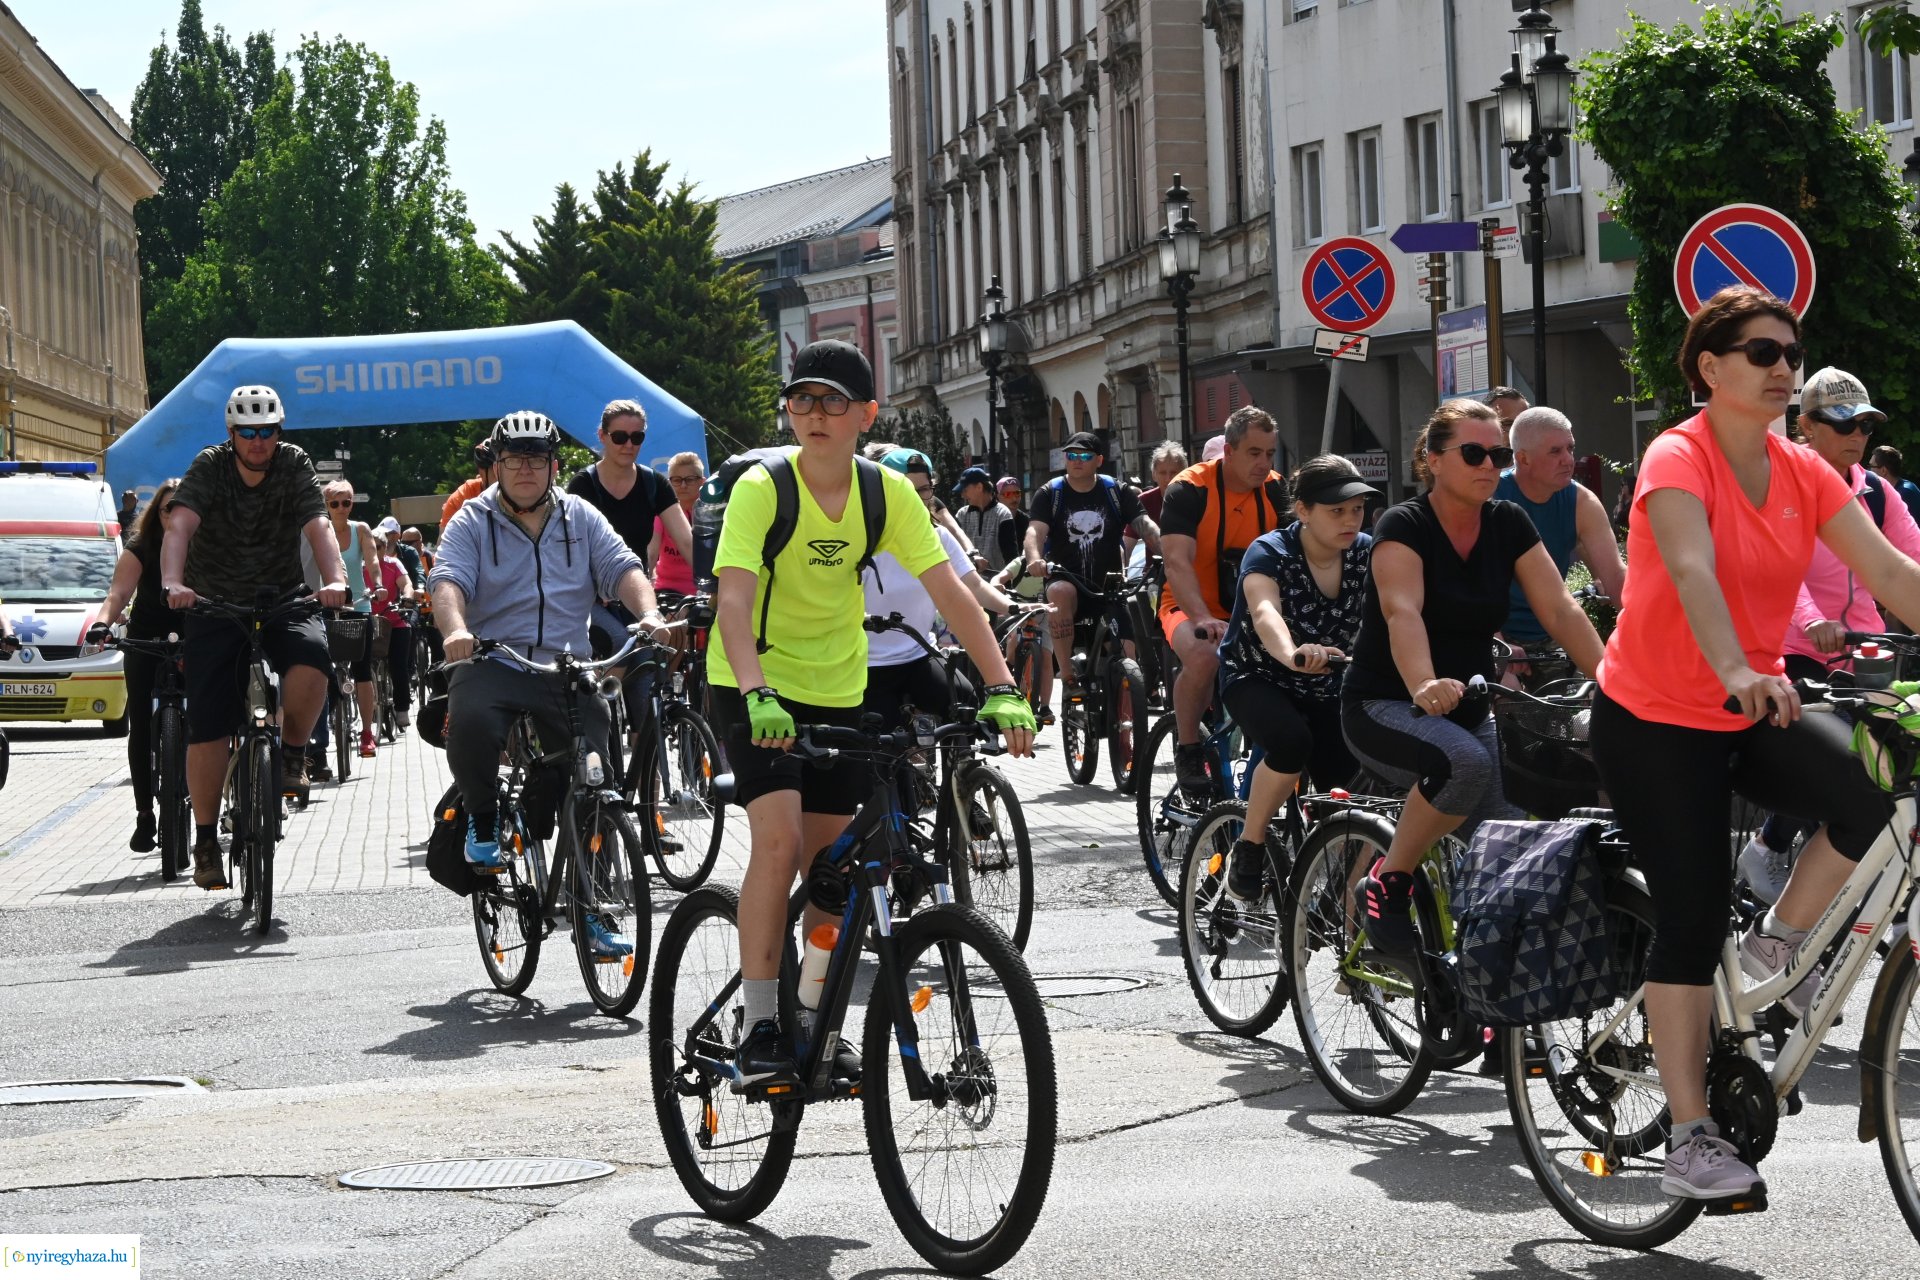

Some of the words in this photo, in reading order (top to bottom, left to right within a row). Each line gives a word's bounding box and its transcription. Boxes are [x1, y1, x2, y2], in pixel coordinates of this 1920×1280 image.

[295, 356, 502, 394] SHIMANO
[808, 557, 843, 566] umbro
[4, 684, 53, 695] RLN-624
